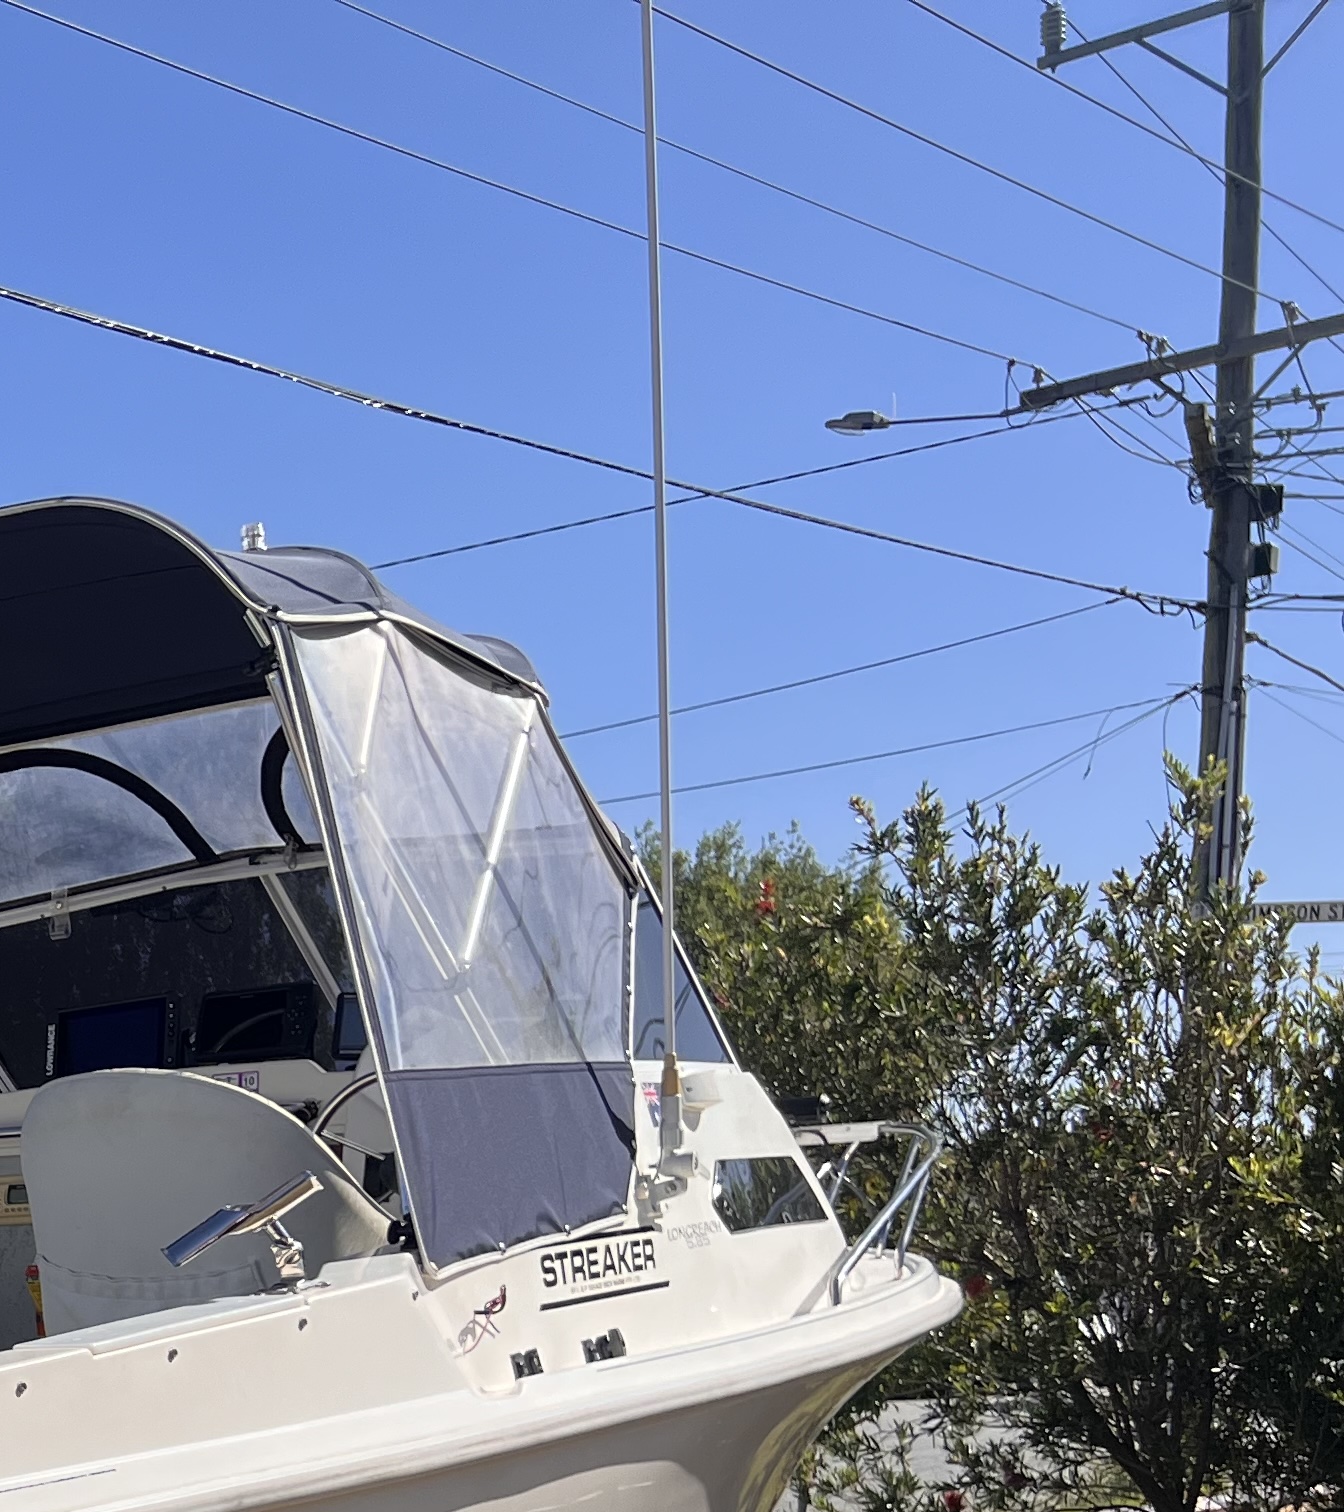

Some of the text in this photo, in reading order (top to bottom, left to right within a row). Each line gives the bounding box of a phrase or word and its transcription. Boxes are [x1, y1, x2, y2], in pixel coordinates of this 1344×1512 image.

[1244, 903, 1344, 921] IMPSON S
[46, 1023, 56, 1076] LOWRANCE
[667, 1219, 723, 1242] LONGREACH
[540, 1238, 656, 1288] STREAKER
